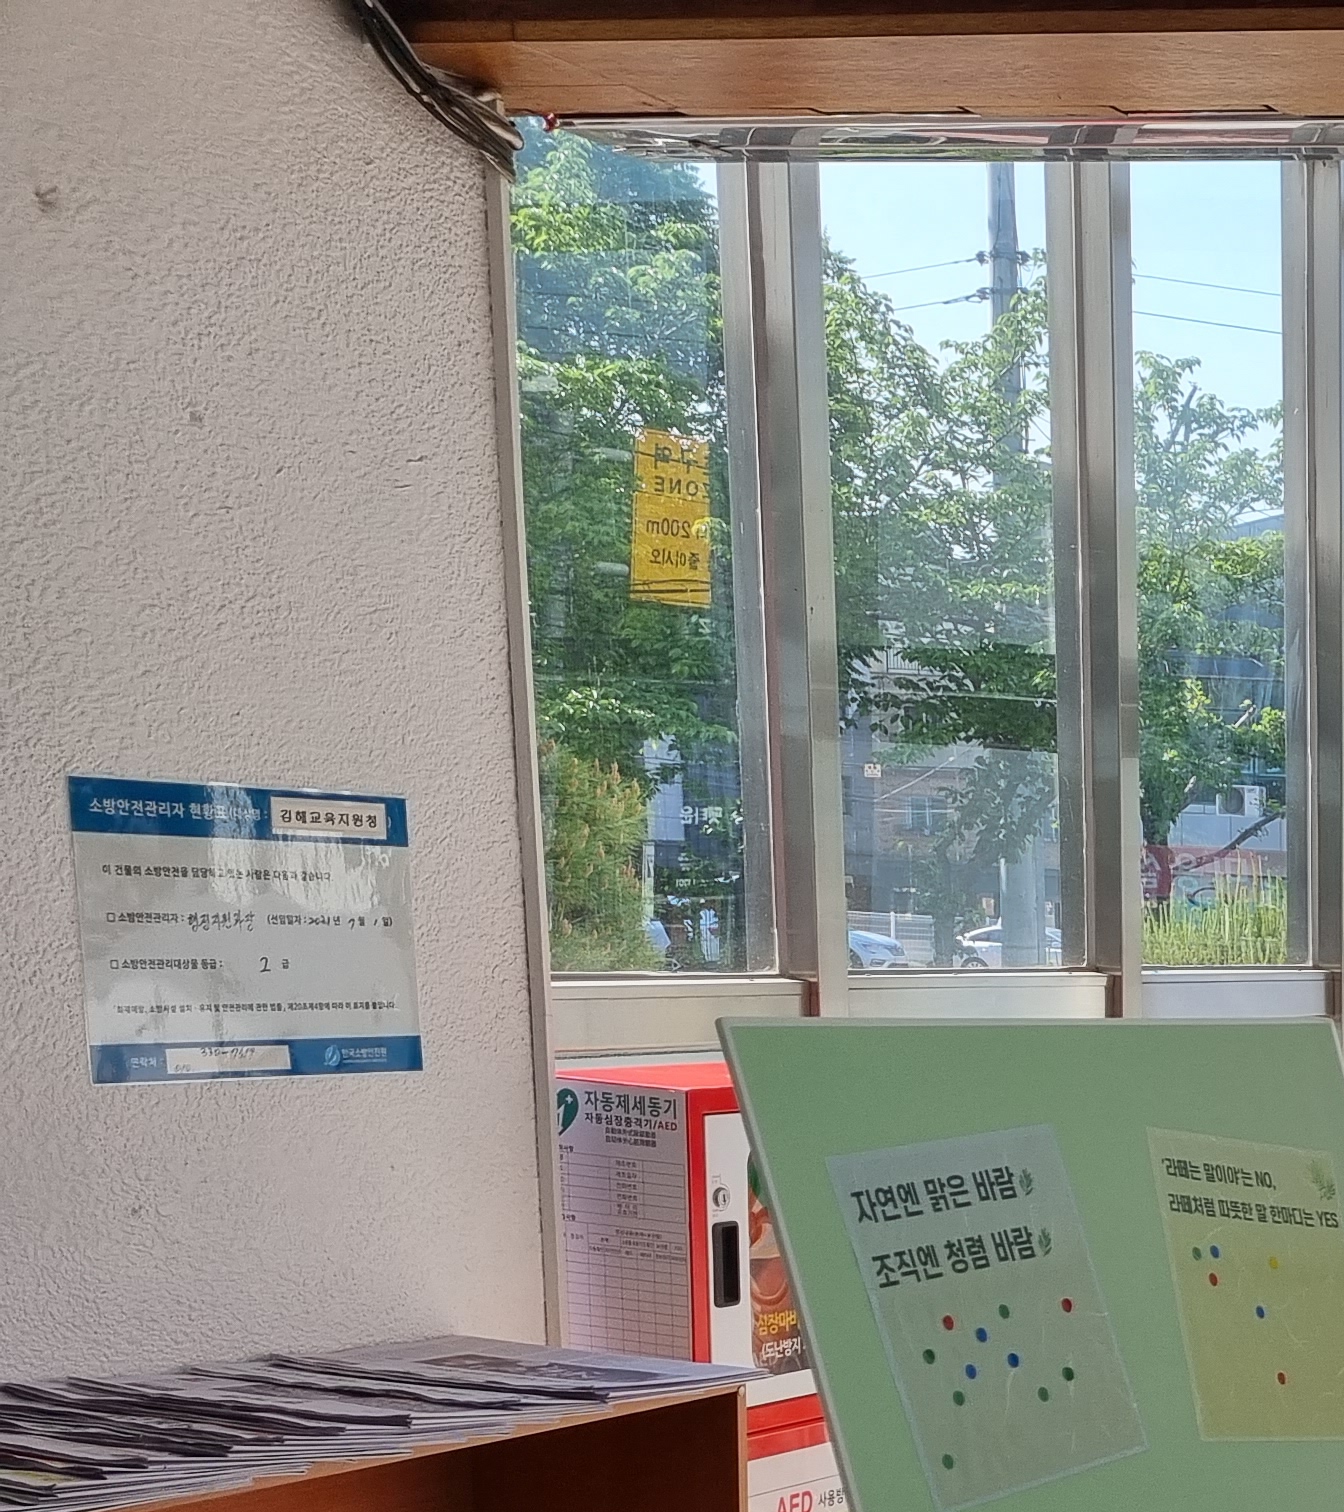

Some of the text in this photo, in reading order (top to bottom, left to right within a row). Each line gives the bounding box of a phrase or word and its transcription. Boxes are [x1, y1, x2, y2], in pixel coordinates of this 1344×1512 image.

[89, 798, 378, 829] 소방안전관리자 김해교육지원청
[584, 1090, 679, 1120] 자동제세동기
[585, 1112, 678, 1131] 자동심장충격기/AED
[850, 1165, 1018, 1225] 자연엔 맑은 바람
[1255, 1169, 1277, 1191] NO,
[1167, 1193, 1339, 1229] 라떼처럼 따뜻한 말 한마디는 YES
[871, 1225, 1038, 1290] 조직엔 청렴 바람
